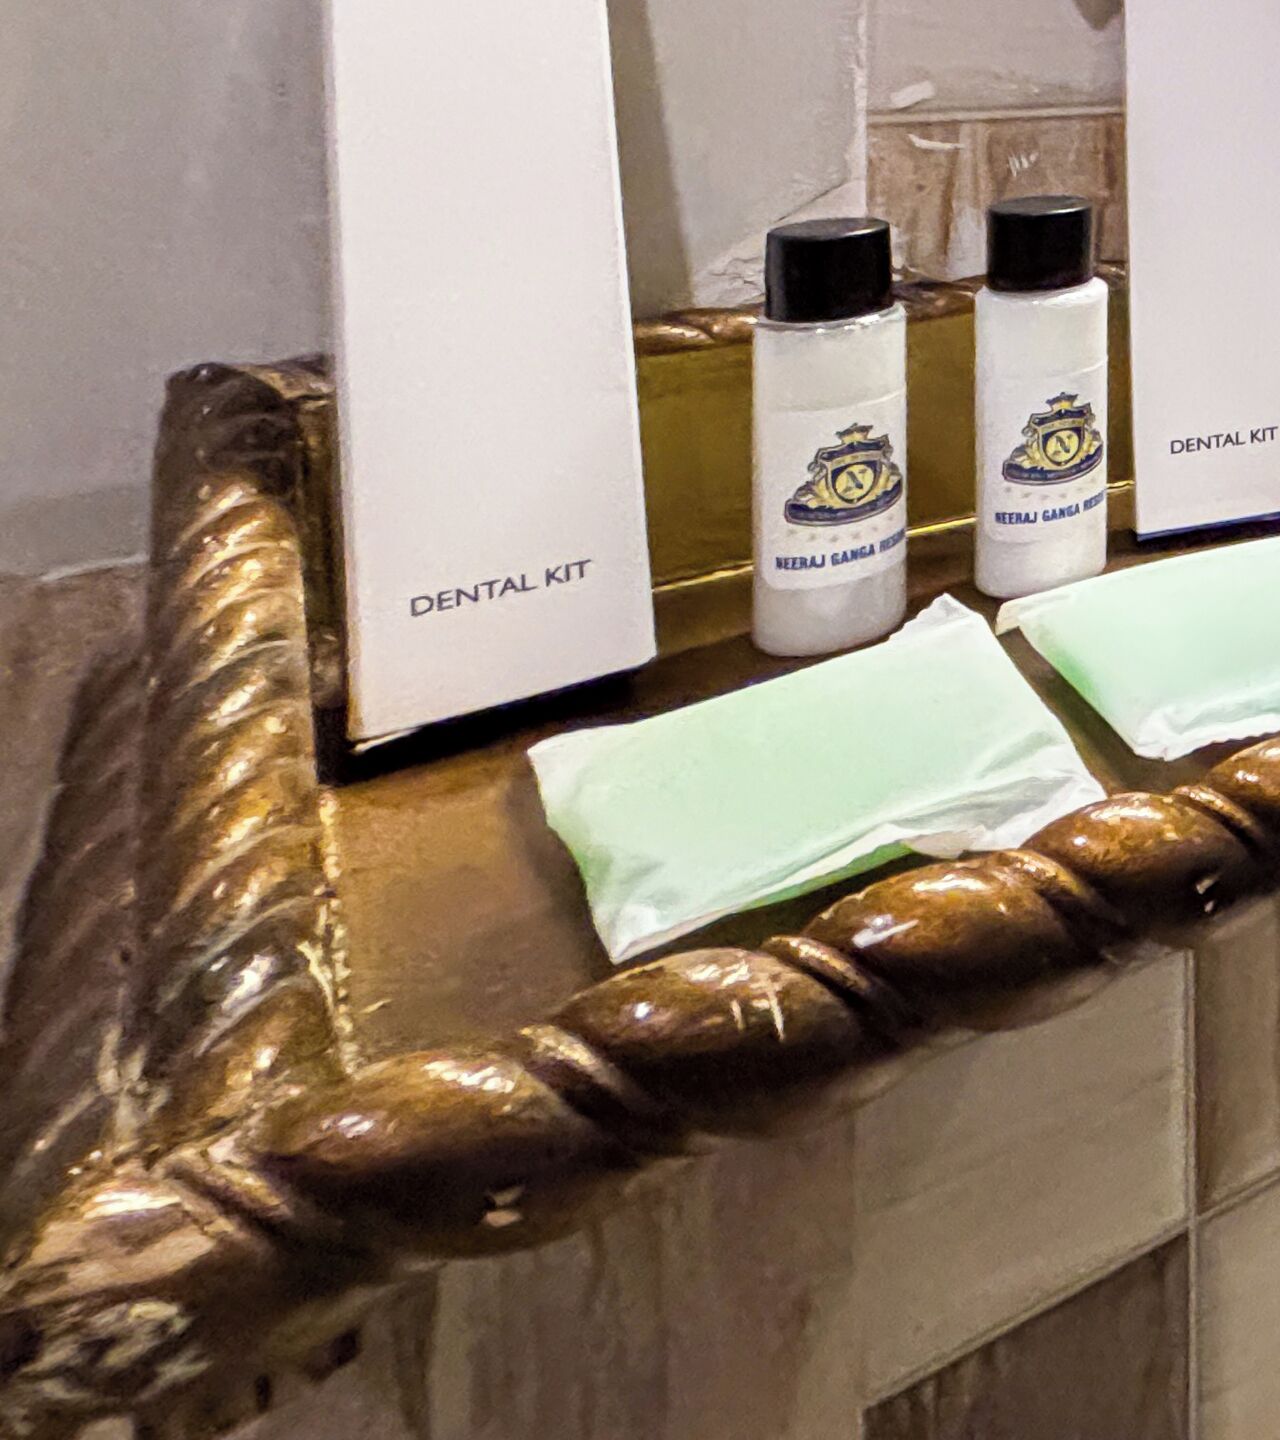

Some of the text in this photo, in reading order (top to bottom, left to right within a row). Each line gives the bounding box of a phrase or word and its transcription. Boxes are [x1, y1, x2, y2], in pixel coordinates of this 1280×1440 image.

[1052, 433, 1074, 457] N
[1170, 426, 1279, 455] DENTAL KIT
[840, 467, 868, 493] N
[994, 512, 1038, 525] NEERAJ
[1041, 503, 1081, 522] GANGA
[774, 554, 827, 571] NEERAJ
[830, 543, 876, 567] GANGA
[410, 558, 592, 618] DENTAL KIT
